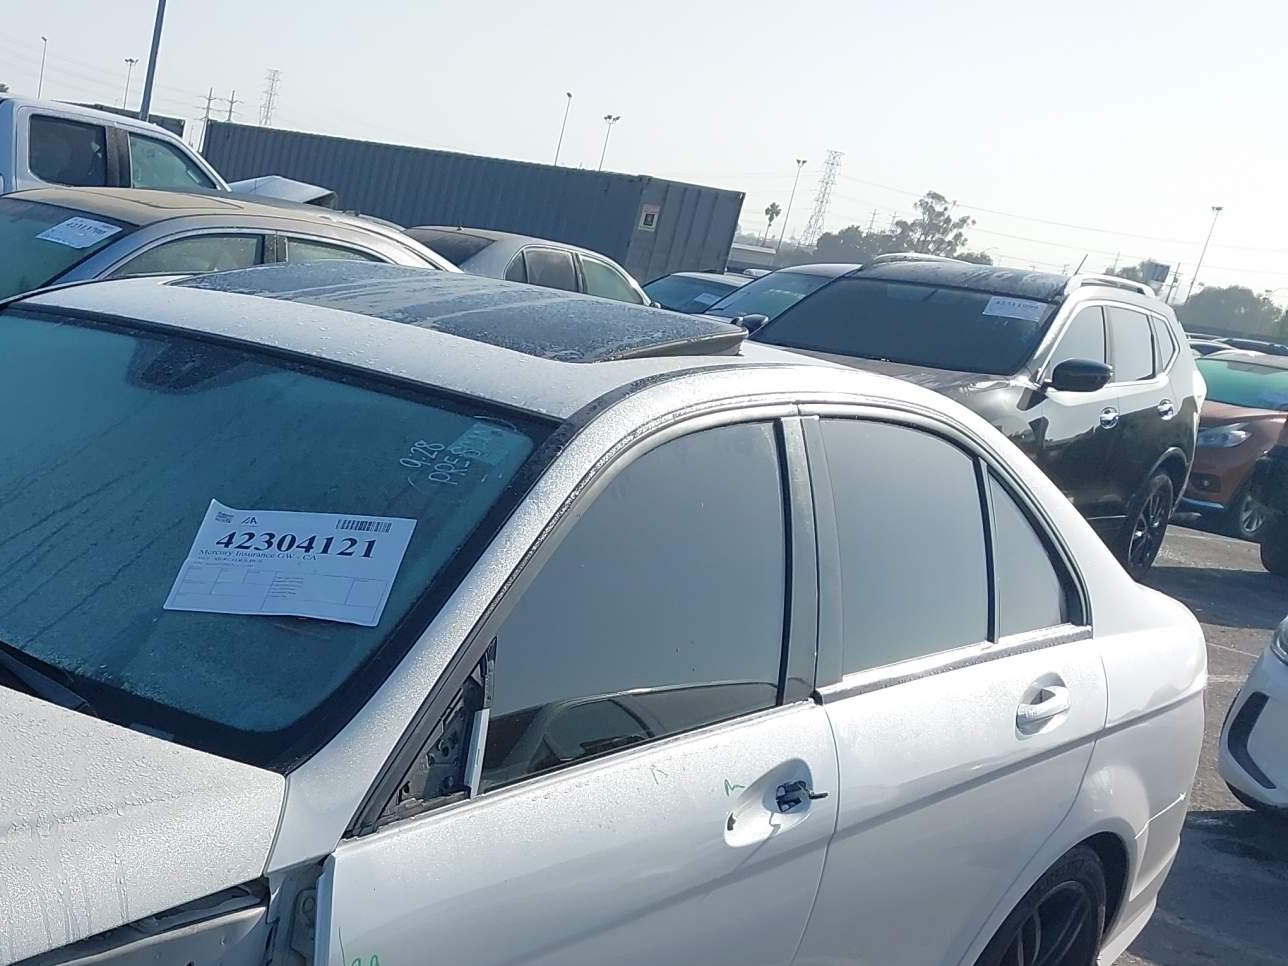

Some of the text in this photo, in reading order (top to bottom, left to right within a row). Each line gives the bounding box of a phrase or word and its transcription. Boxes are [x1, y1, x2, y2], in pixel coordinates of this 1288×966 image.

[199, 549, 233, 557] Mercury
[235, 550, 275, 559] Insurance
[215, 531, 378, 559] 42304121
